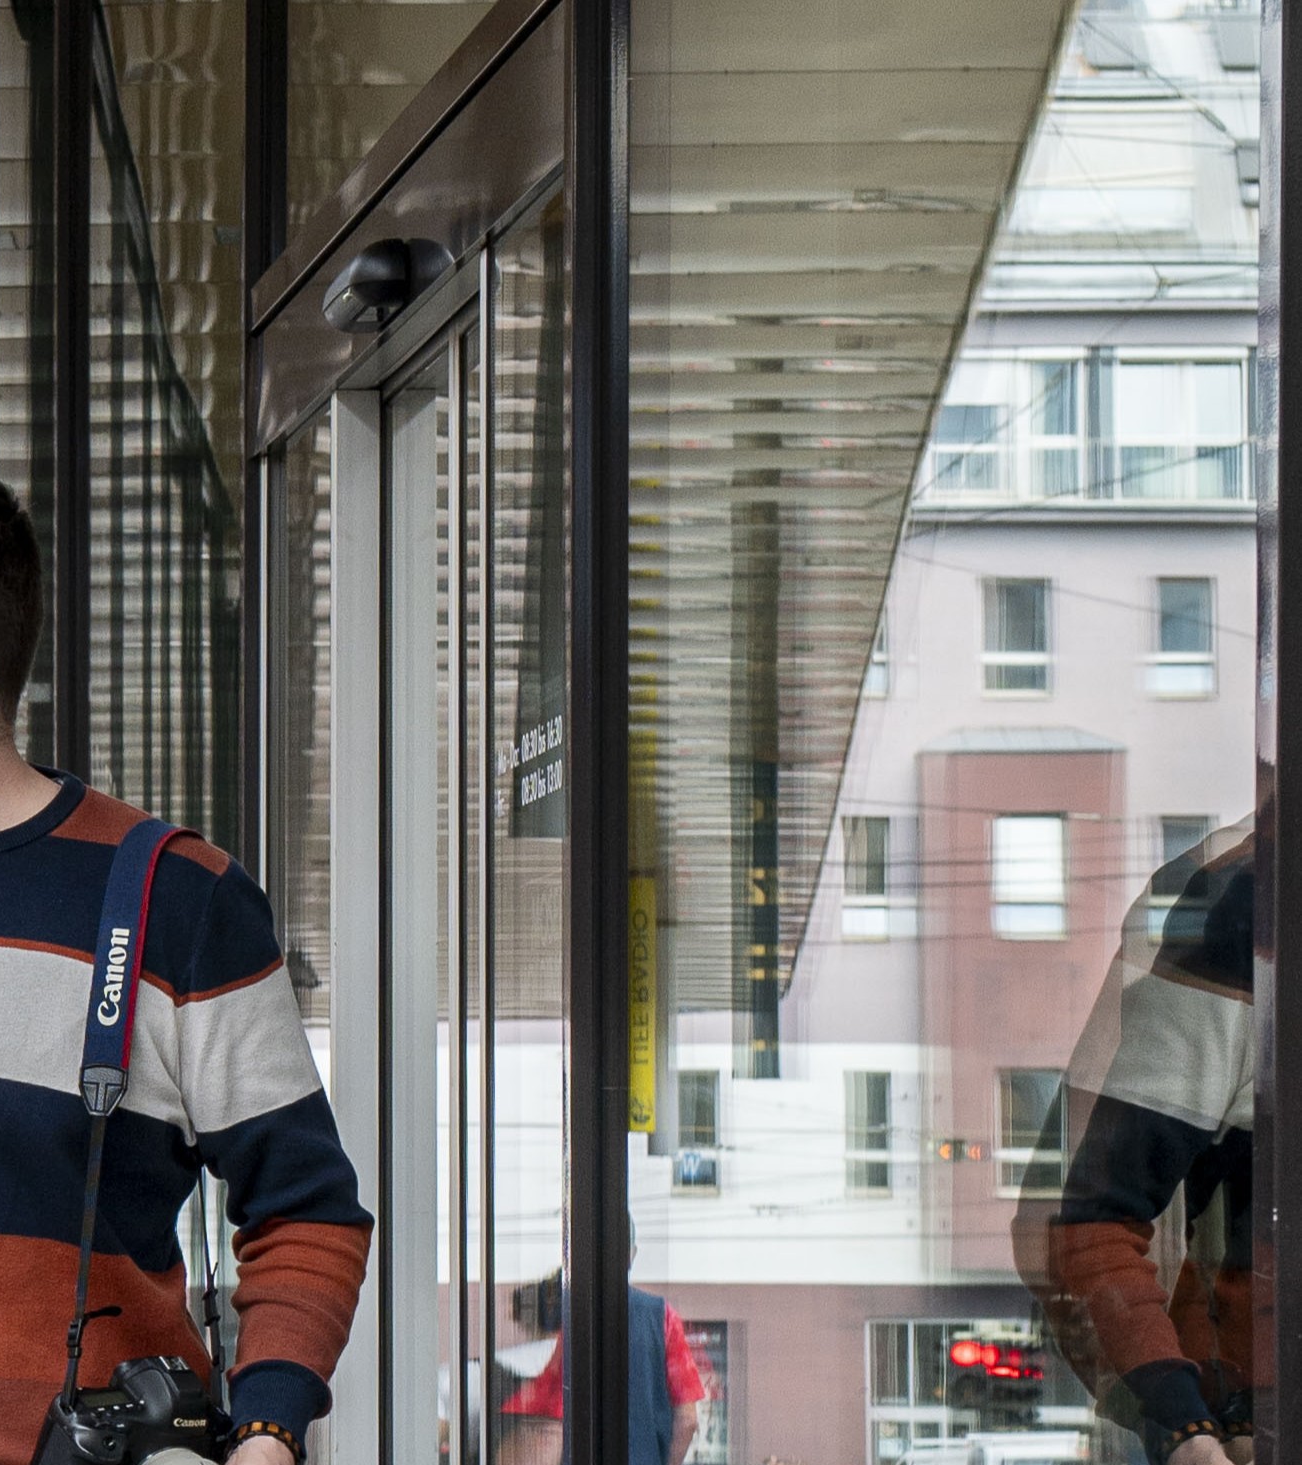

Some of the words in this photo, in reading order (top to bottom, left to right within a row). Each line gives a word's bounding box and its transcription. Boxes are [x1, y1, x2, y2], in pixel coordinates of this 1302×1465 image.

[537, 723, 546, 755] bis
[537, 767, 546, 799] bis
[97, 927, 130, 1026] Canon
[173, 1417, 208, 1428] Canon
